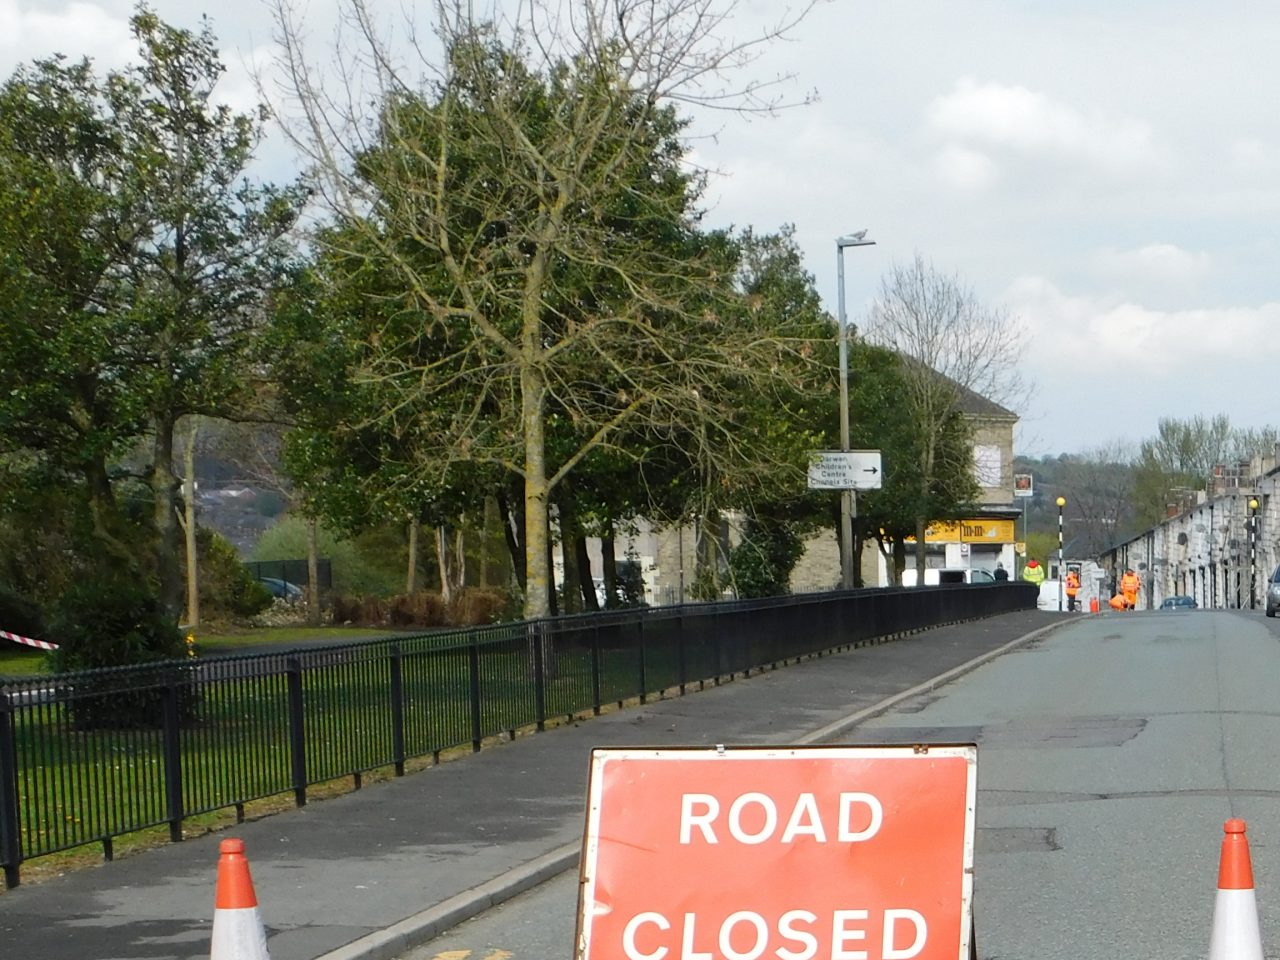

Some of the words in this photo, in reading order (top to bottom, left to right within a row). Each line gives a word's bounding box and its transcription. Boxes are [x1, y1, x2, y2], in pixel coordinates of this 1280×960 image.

[821, 470, 846, 478] Centre
[843, 478, 857, 486] Site
[679, 792, 883, 844] ROAD
